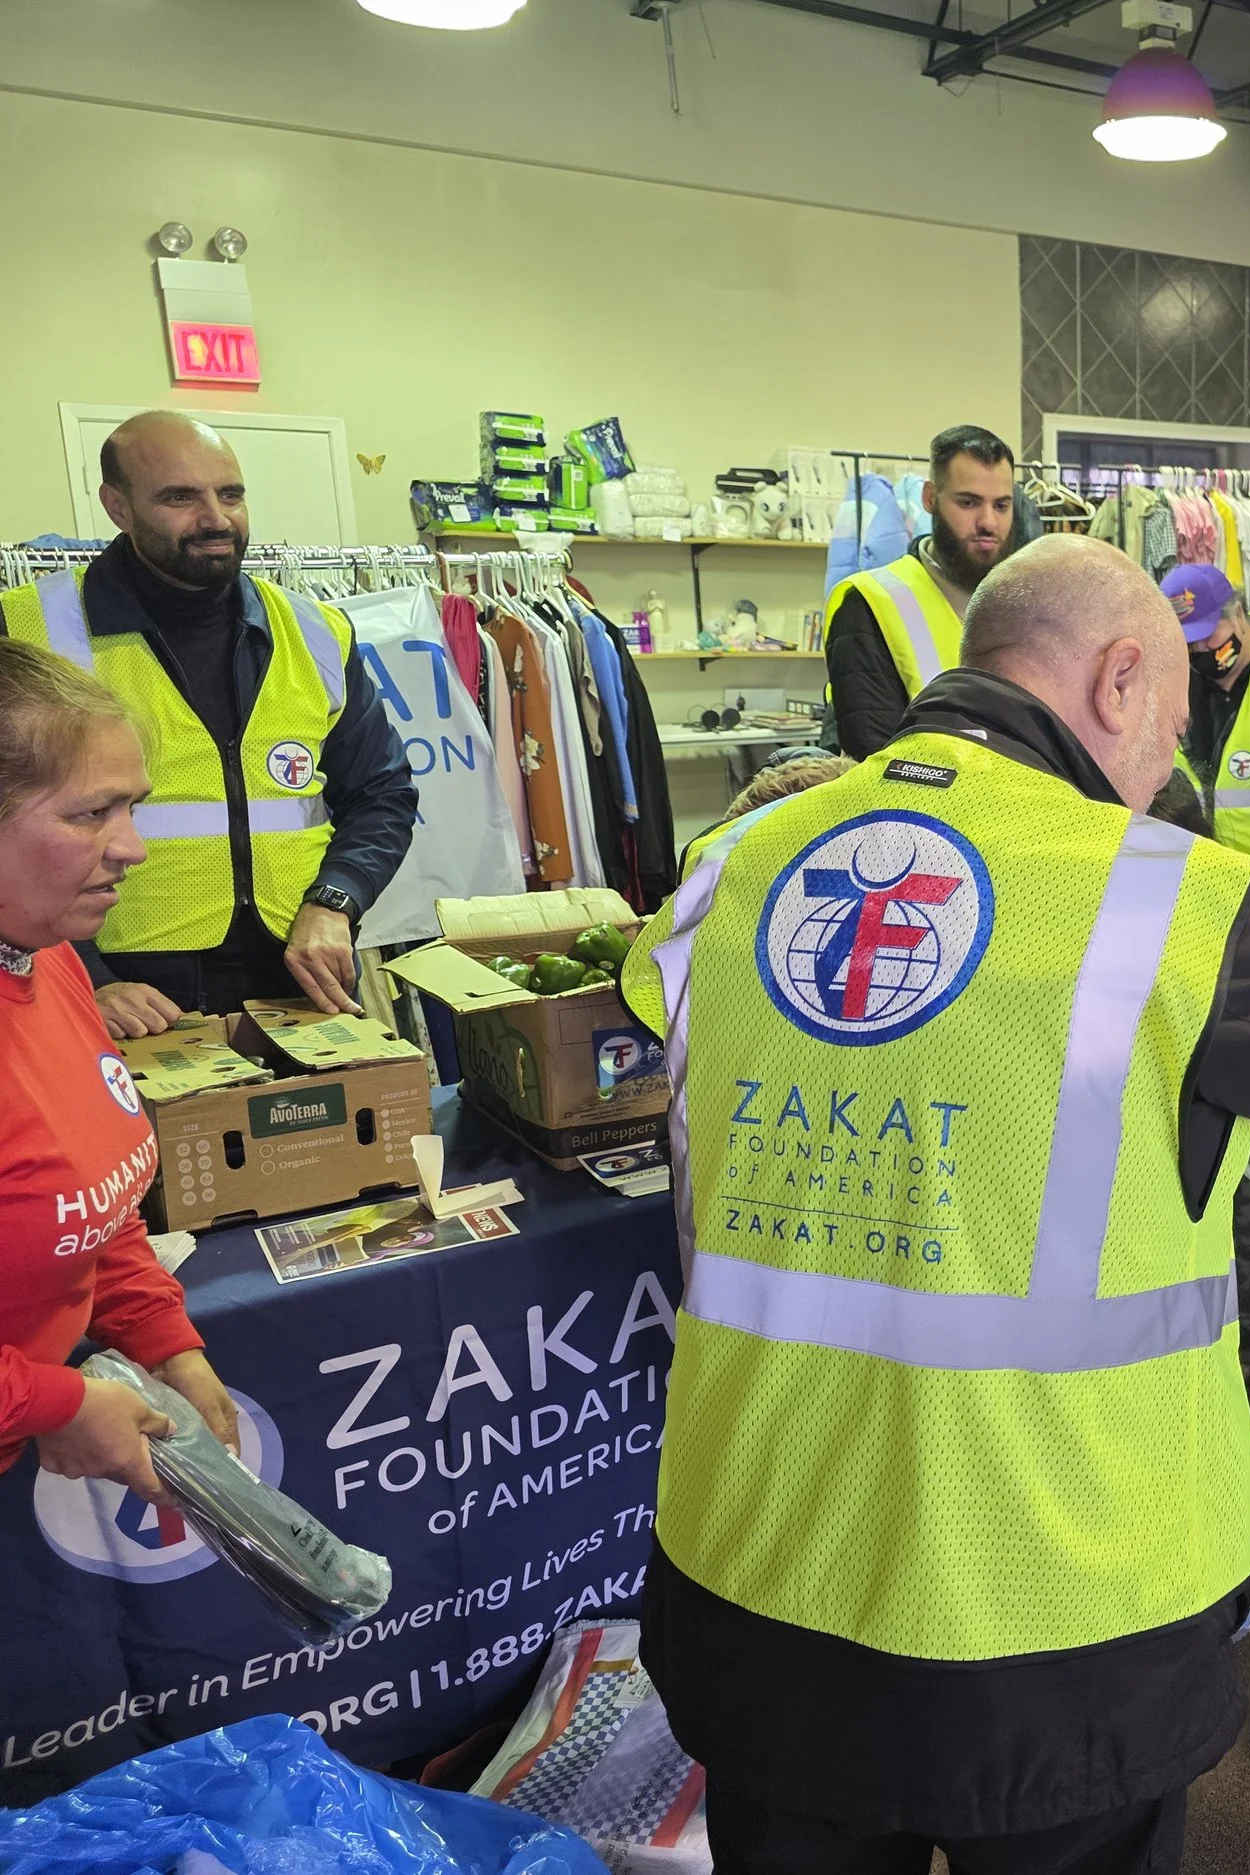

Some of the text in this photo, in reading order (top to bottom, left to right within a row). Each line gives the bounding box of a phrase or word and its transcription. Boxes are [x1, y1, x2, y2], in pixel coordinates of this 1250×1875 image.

[181, 331, 245, 372] EXIT
[434, 488, 465, 504] Prevail
[902, 763, 943, 777] KISHIGO
[183, 1123, 199, 1132] SIZE
[391, 1118, 416, 1127] Mexico
[392, 1129, 411, 1138] Chile
[731, 1080, 968, 1147] ZAKAT
[277, 1134, 344, 1153] Conventional
[572, 1121, 657, 1148] Bell Peppers
[728, 1133, 956, 1177] FOUNDATION
[279, 1155, 321, 1169] Organic
[728, 1163, 952, 1207] of AMERICA
[55, 1204, 128, 1256] above
[471, 1210, 499, 1232] NEWS
[726, 1209, 942, 1264] ZAKAT.ORG
[319, 1270, 676, 1449] ZAKA
[334, 1365, 672, 1510] FOUNDATI
[428, 1423, 664, 1535] of AMERIC
[3, 1690, 178, 1769] Leader
[188, 1673, 229, 1707] in
[242, 1575, 512, 1690] Empowering
[521, 1528, 604, 1591] Lives
